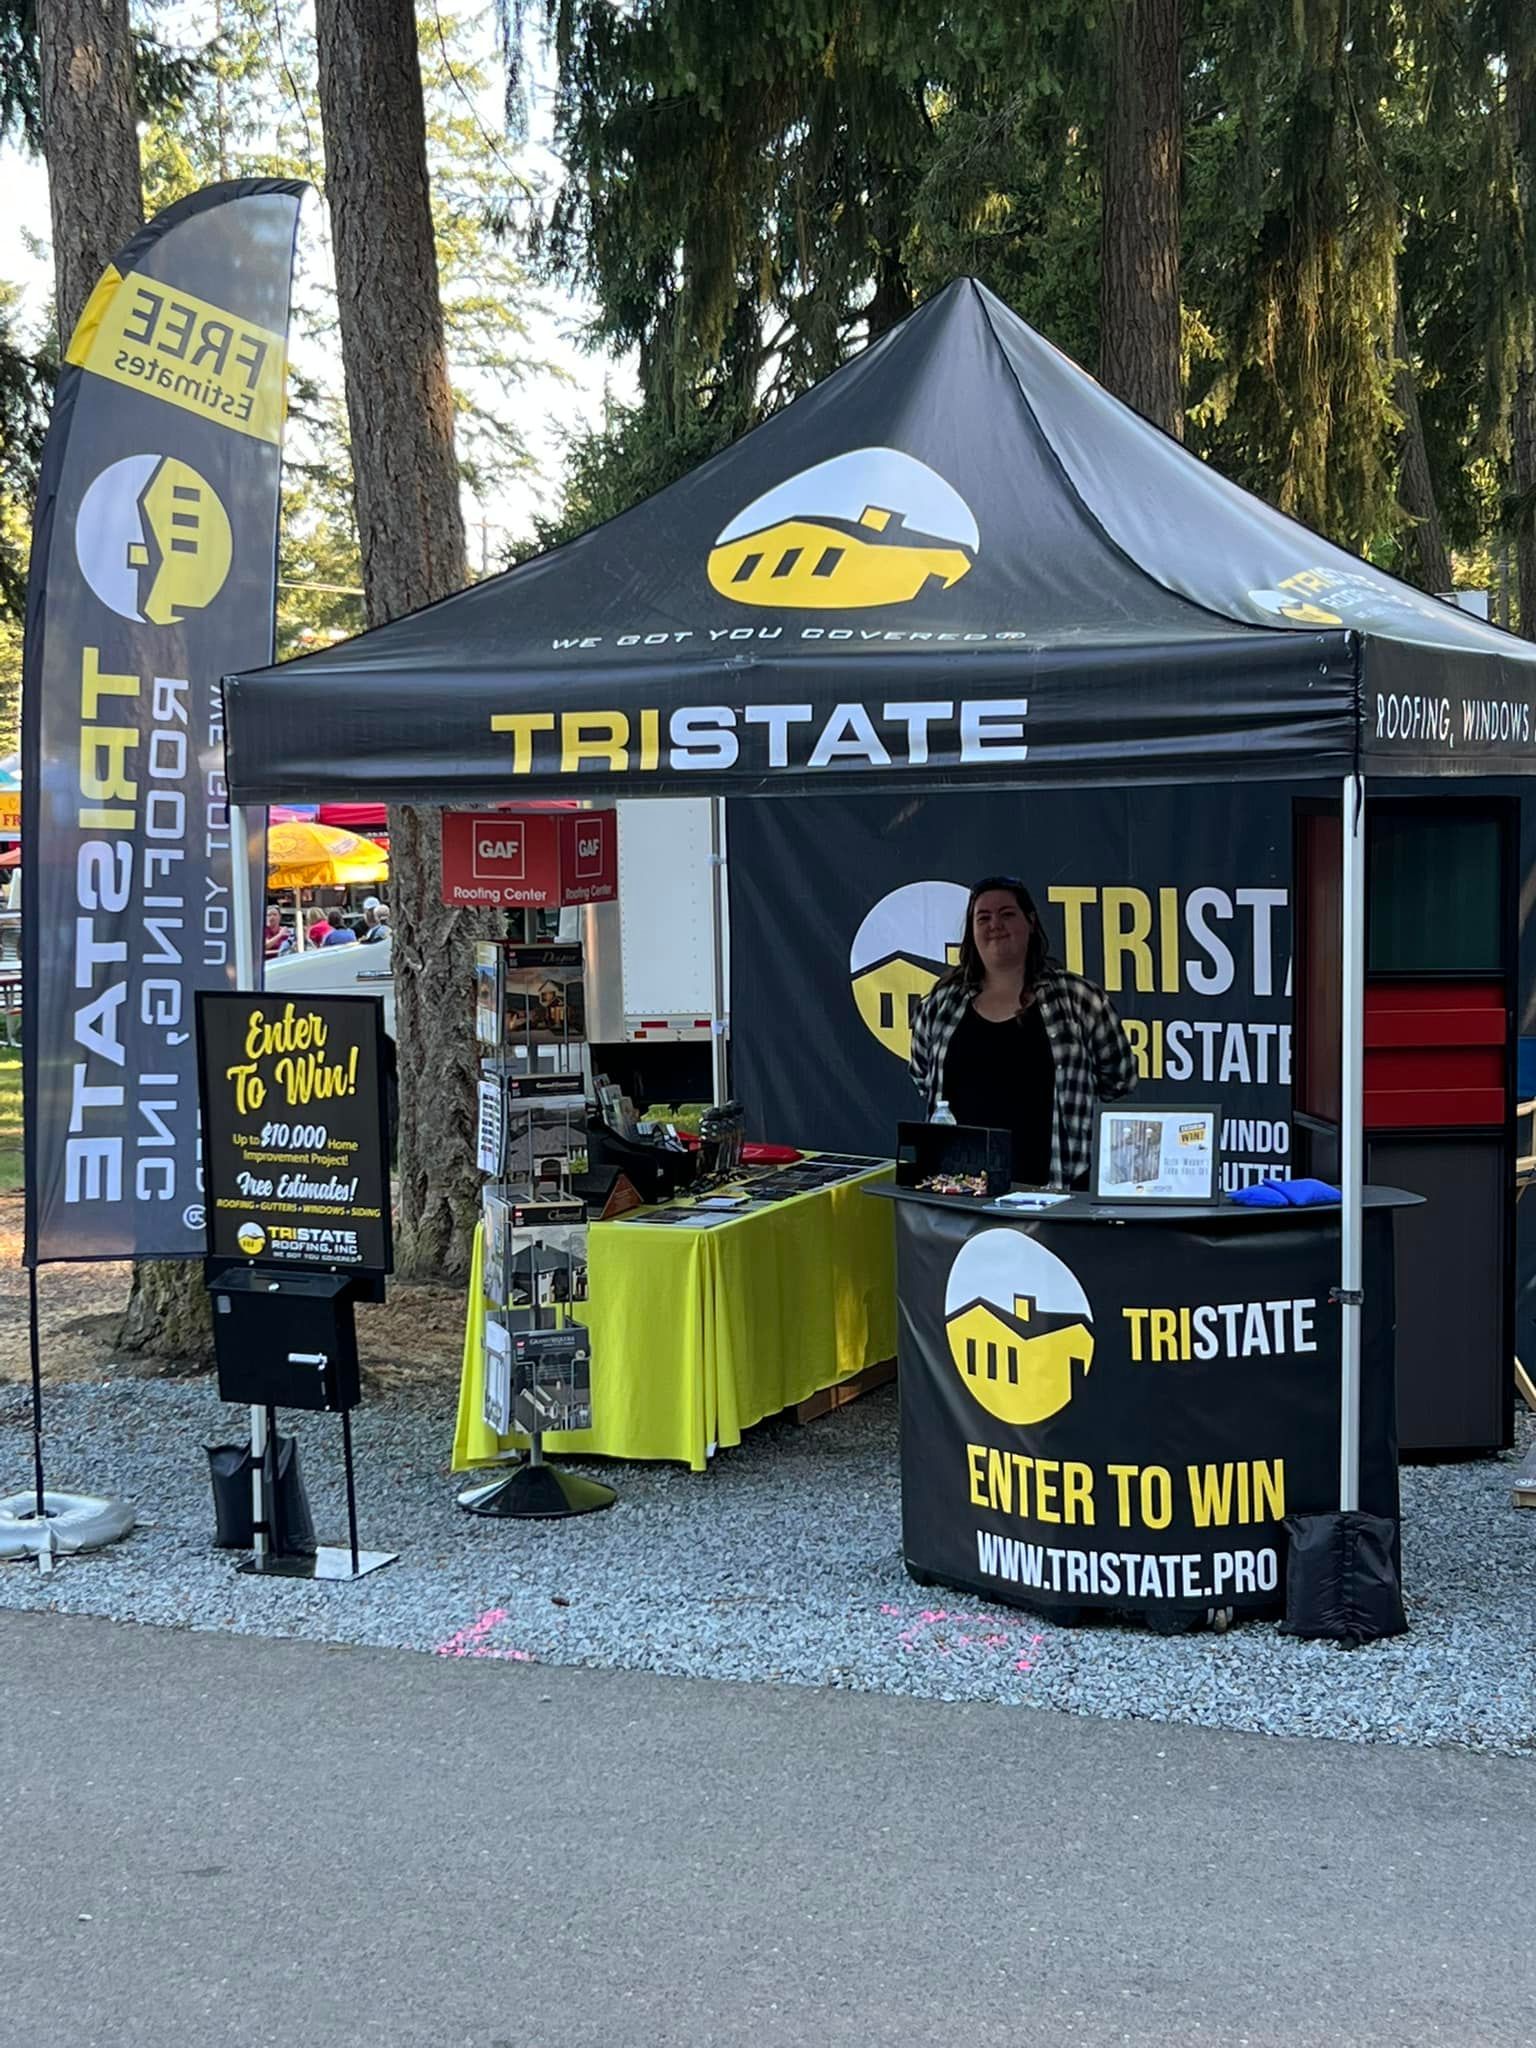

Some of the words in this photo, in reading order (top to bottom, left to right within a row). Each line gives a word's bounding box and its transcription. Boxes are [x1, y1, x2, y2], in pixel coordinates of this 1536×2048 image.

[552, 637, 602, 650] WE
[616, 631, 693, 647] GOT
[708, 627, 782, 641] YOU
[1376, 692, 1454, 749] ROOFING,
[1462, 699, 1529, 743] WINDOWS
[490, 698, 1028, 774] TRISTATE
[479, 839, 518, 858] GAF
[578, 838, 600, 858] GAF
[453, 886, 500, 902] Roofing
[504, 886, 547, 901] Center
[1048, 885, 1291, 997] TRIST
[245, 1003, 328, 1059] Enter
[226, 1062, 267, 1115] To
[274, 1045, 359, 1105] Win!
[232, 1133, 249, 1147] Up
[250, 1134, 260, 1145] to
[260, 1121, 327, 1149] $10,000
[328, 1138, 359, 1151] Home
[243, 1150, 309, 1164] Improvement
[311, 1152, 349, 1167] Project!
[235, 1171, 274, 1198] Free
[277, 1173, 359, 1202] Estimates!
[216, 1198, 255, 1210] ROOFING
[260, 1201, 297, 1212] GUTTERS
[303, 1204, 345, 1216] WINDOWS
[351, 1207, 381, 1219] SIDING
[267, 1225, 358, 1244] TRISTATE
[271, 1239, 333, 1253] ROOFING,
[334, 1244, 359, 1255] INC
[1122, 1298, 1317, 1362] TRISTATE
[966, 1443, 1096, 1526] ENTER
[1107, 1464, 1173, 1529] TO
[1187, 1458, 1286, 1528] WIN
[976, 1529, 1278, 1599] WWW.TRISTATE.PRO
